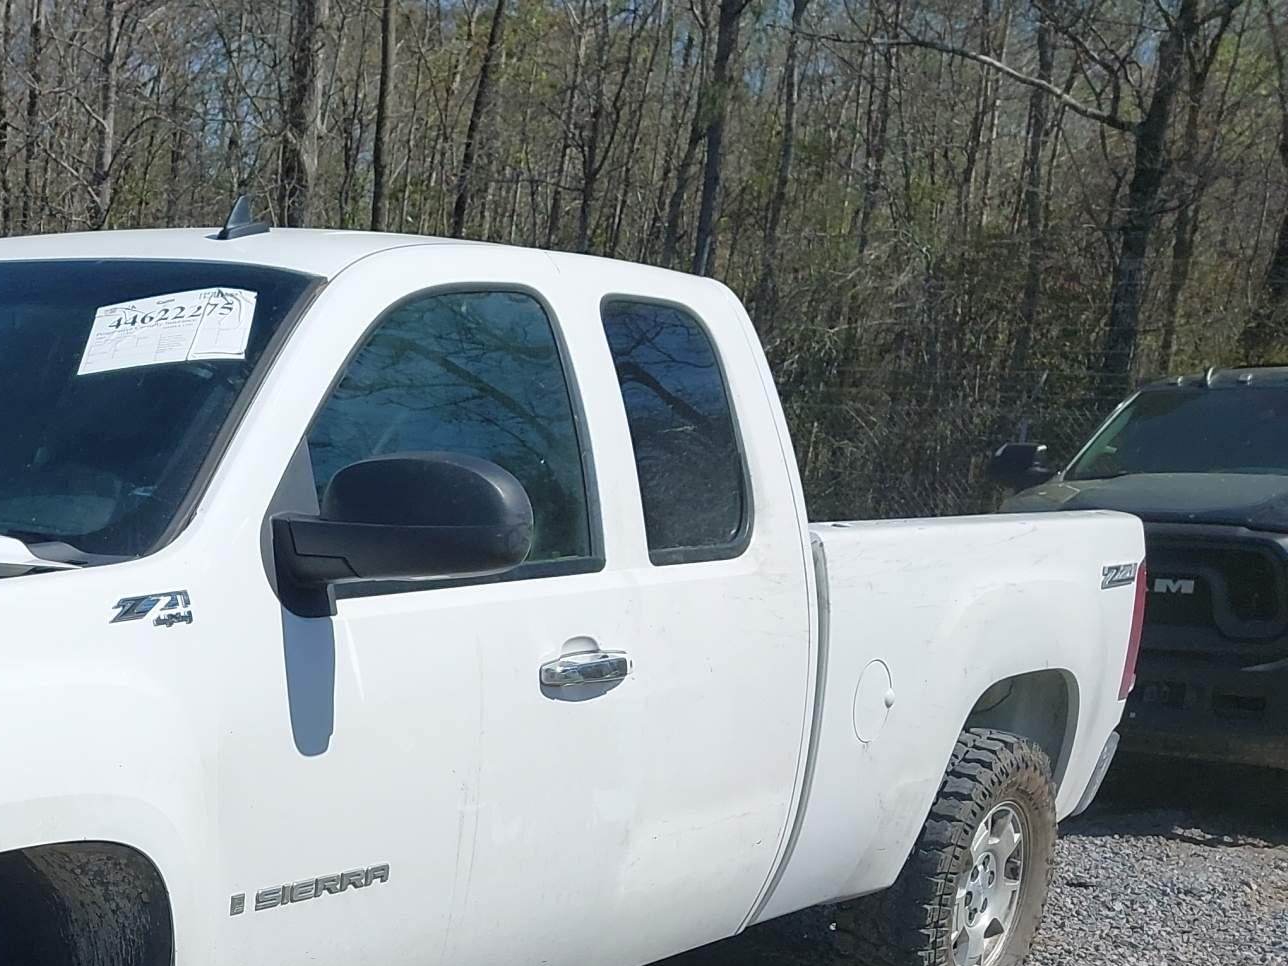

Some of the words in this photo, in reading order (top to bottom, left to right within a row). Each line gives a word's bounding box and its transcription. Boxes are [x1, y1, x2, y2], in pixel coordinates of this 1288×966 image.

[109, 300, 234, 330] 44622275
[109, 589, 191, 624] Z71
[254, 863, 390, 912] SIERRA
